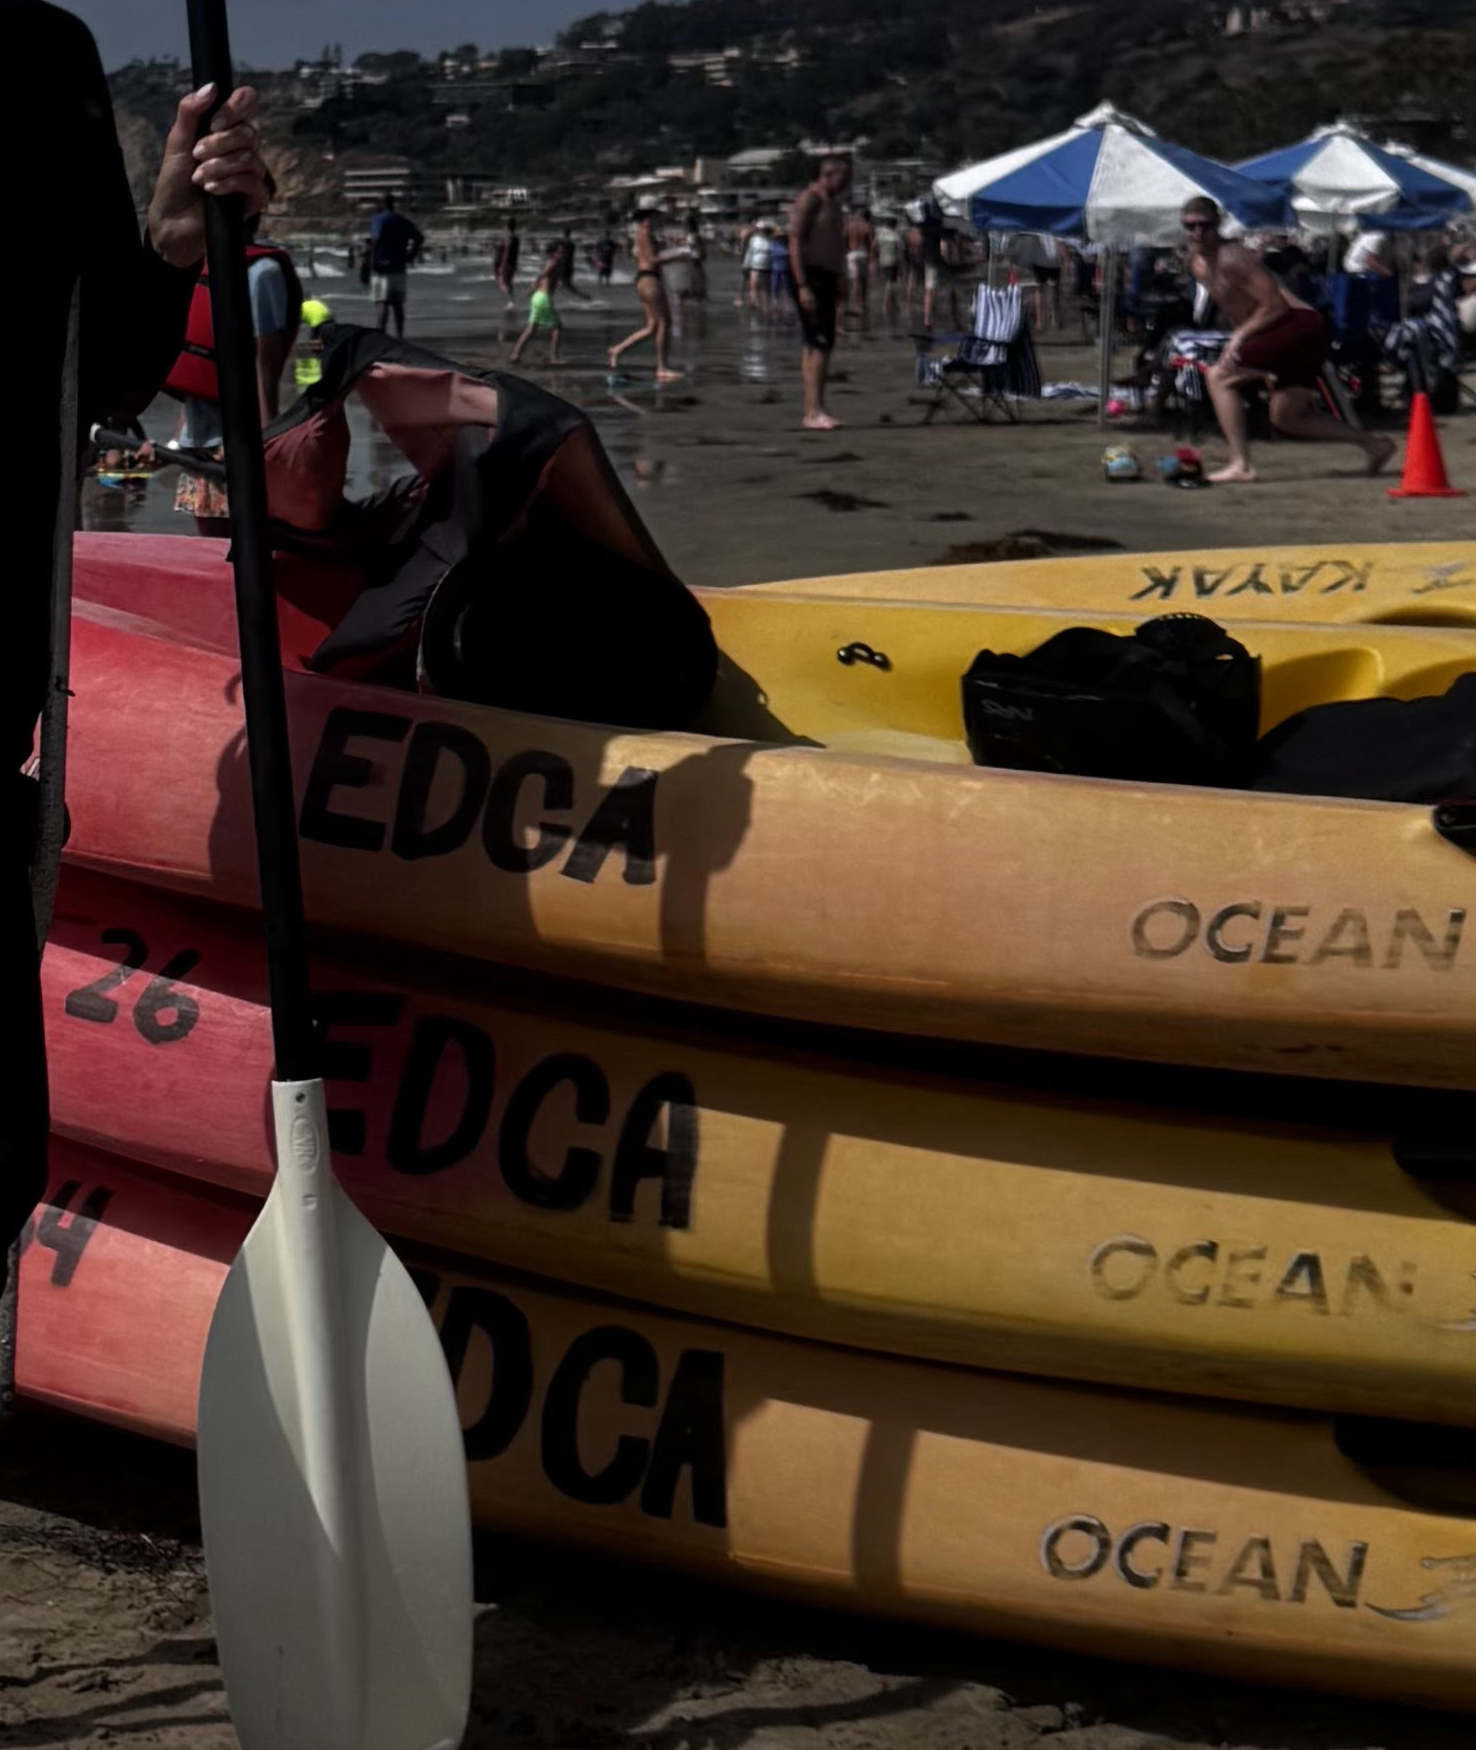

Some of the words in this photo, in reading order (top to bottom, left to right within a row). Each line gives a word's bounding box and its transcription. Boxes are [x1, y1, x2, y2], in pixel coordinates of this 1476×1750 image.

[1129, 560, 1374, 600] KAYAK
[299, 707, 659, 886] EDCA
[1131, 897, 1467, 970] OCEAN
[65, 928, 200, 1044] 26
[23, 1179, 114, 1287] 4
[1090, 1234, 1418, 1316] OCEAN
[411, 1272, 727, 1528] DCA
[1041, 1513, 1369, 1610] OCEAN
